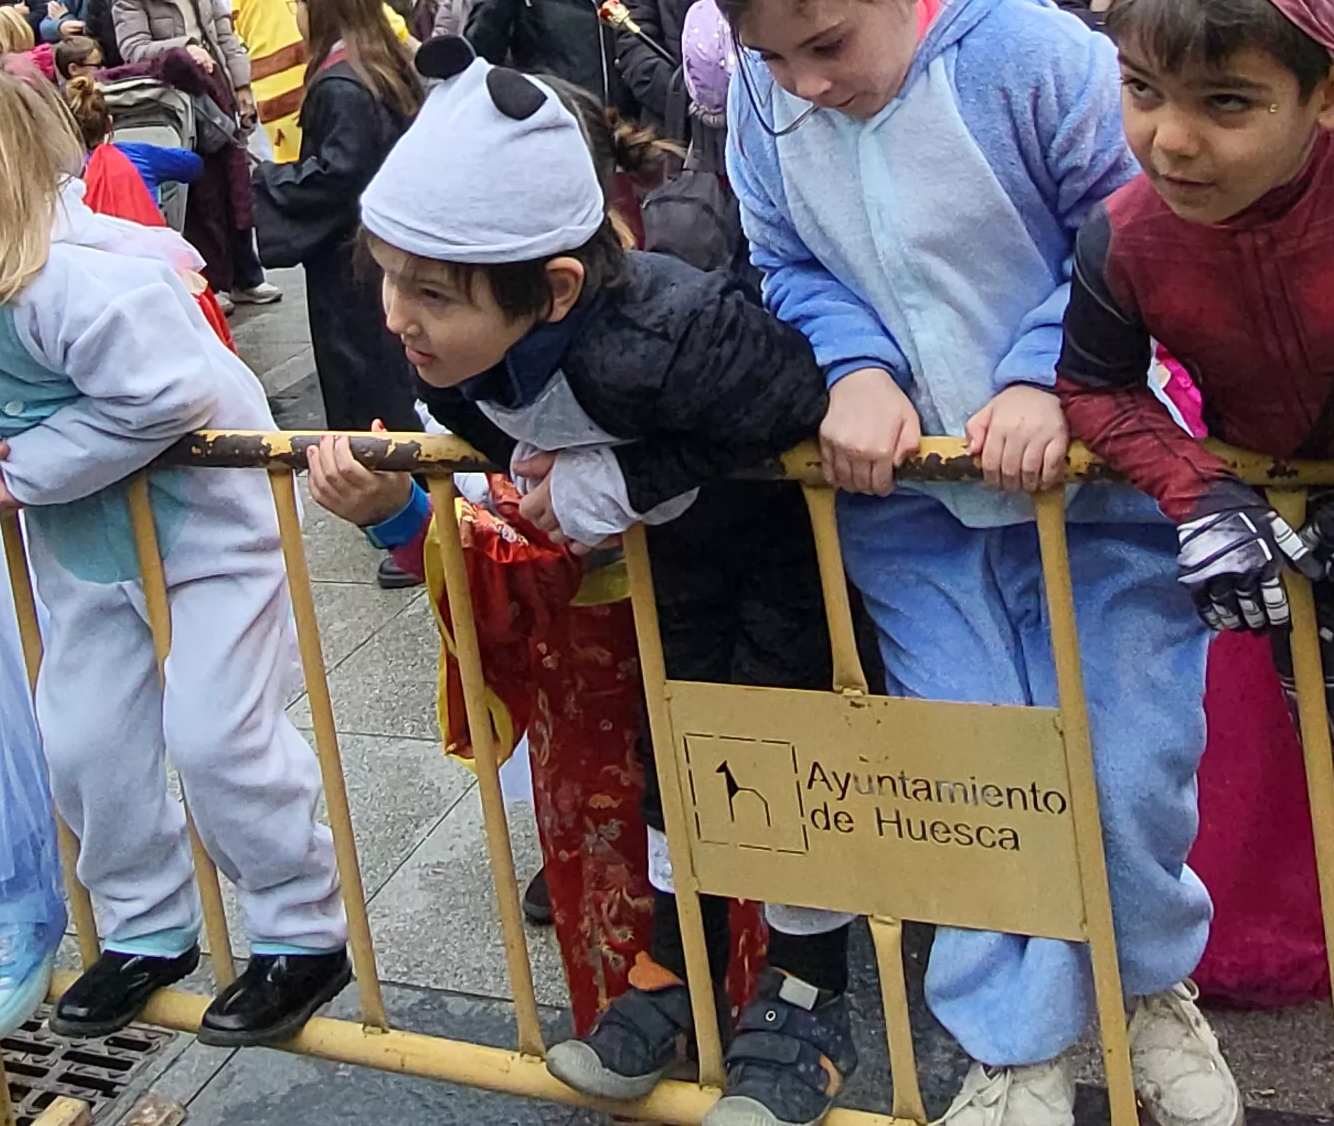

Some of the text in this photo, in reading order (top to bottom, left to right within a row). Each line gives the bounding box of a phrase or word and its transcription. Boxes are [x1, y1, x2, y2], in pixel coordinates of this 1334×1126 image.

[807, 760, 1067, 815] Ayuntamiento
[810, 801, 1021, 852] de Huesca
